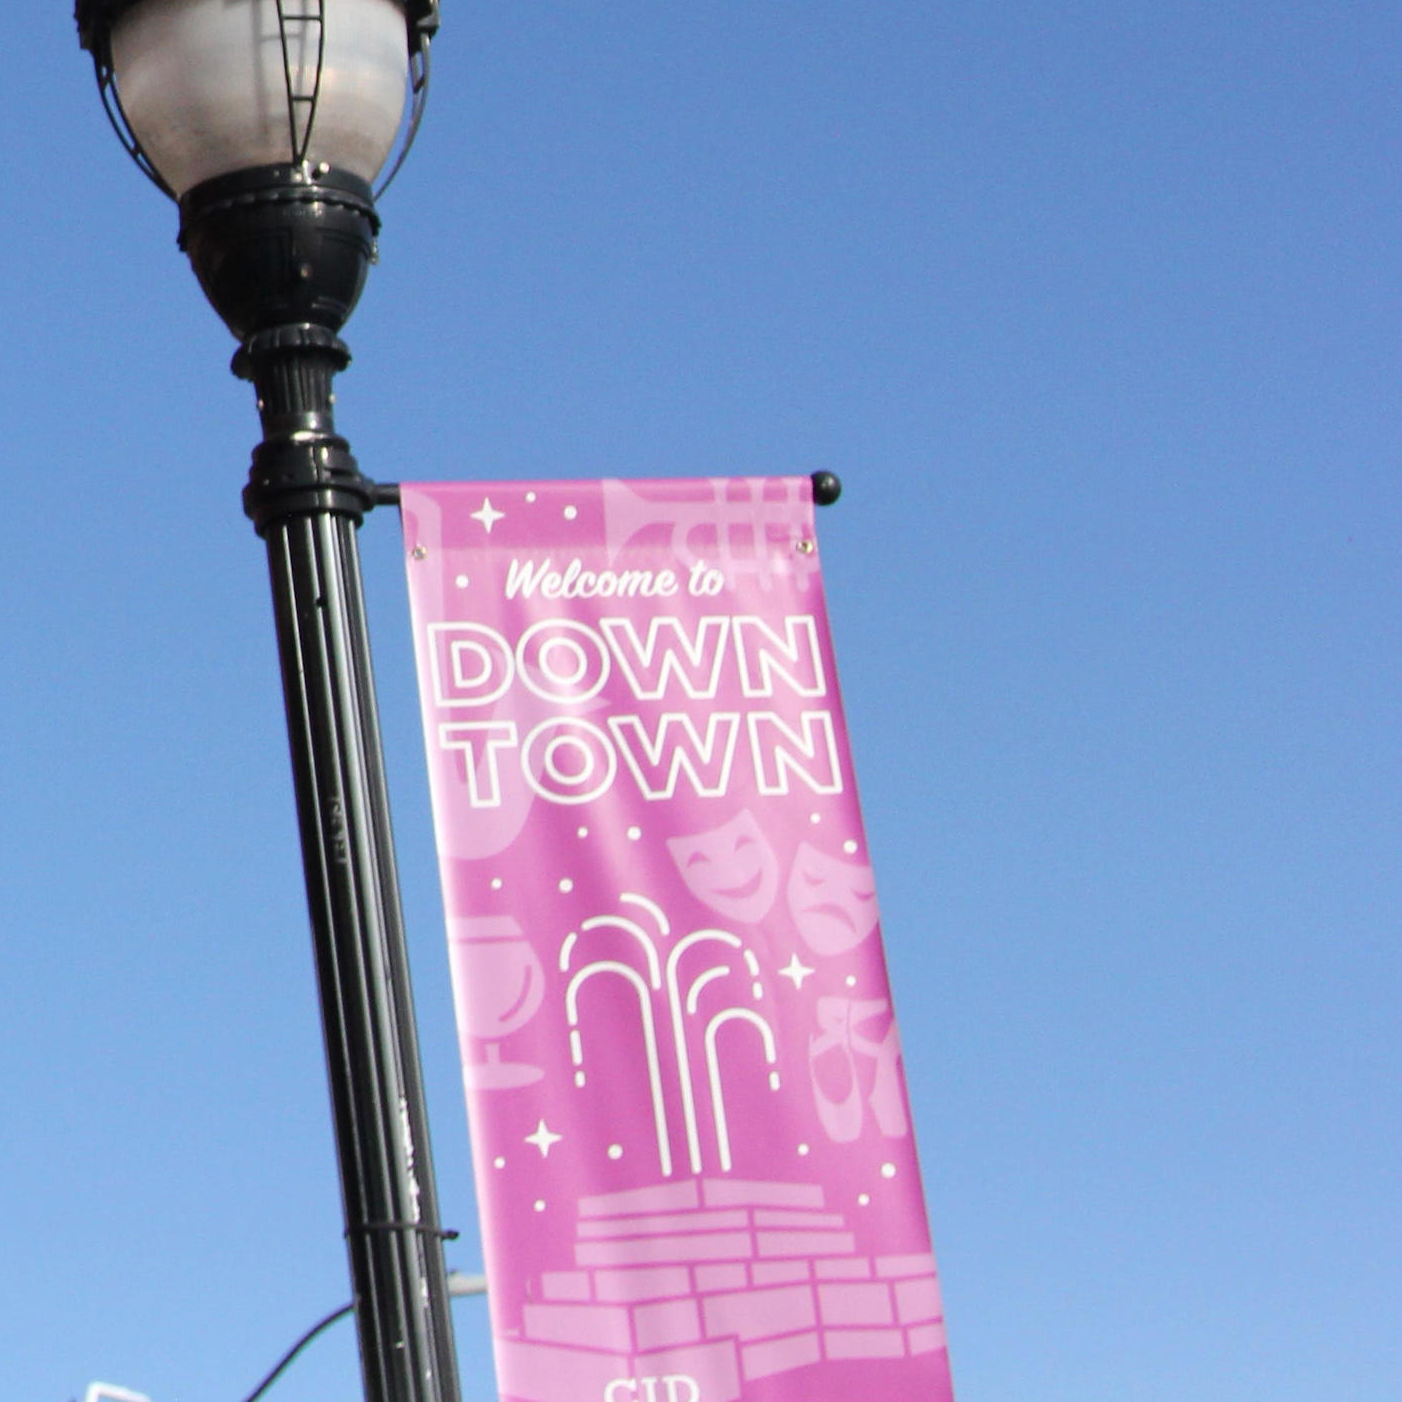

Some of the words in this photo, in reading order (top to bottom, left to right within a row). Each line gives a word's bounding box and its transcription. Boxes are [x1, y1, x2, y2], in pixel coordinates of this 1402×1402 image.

[505, 557, 679, 599] Welcome
[687, 558, 726, 597] to
[426, 614, 827, 706] DOWN
[439, 710, 843, 808] TOWN
